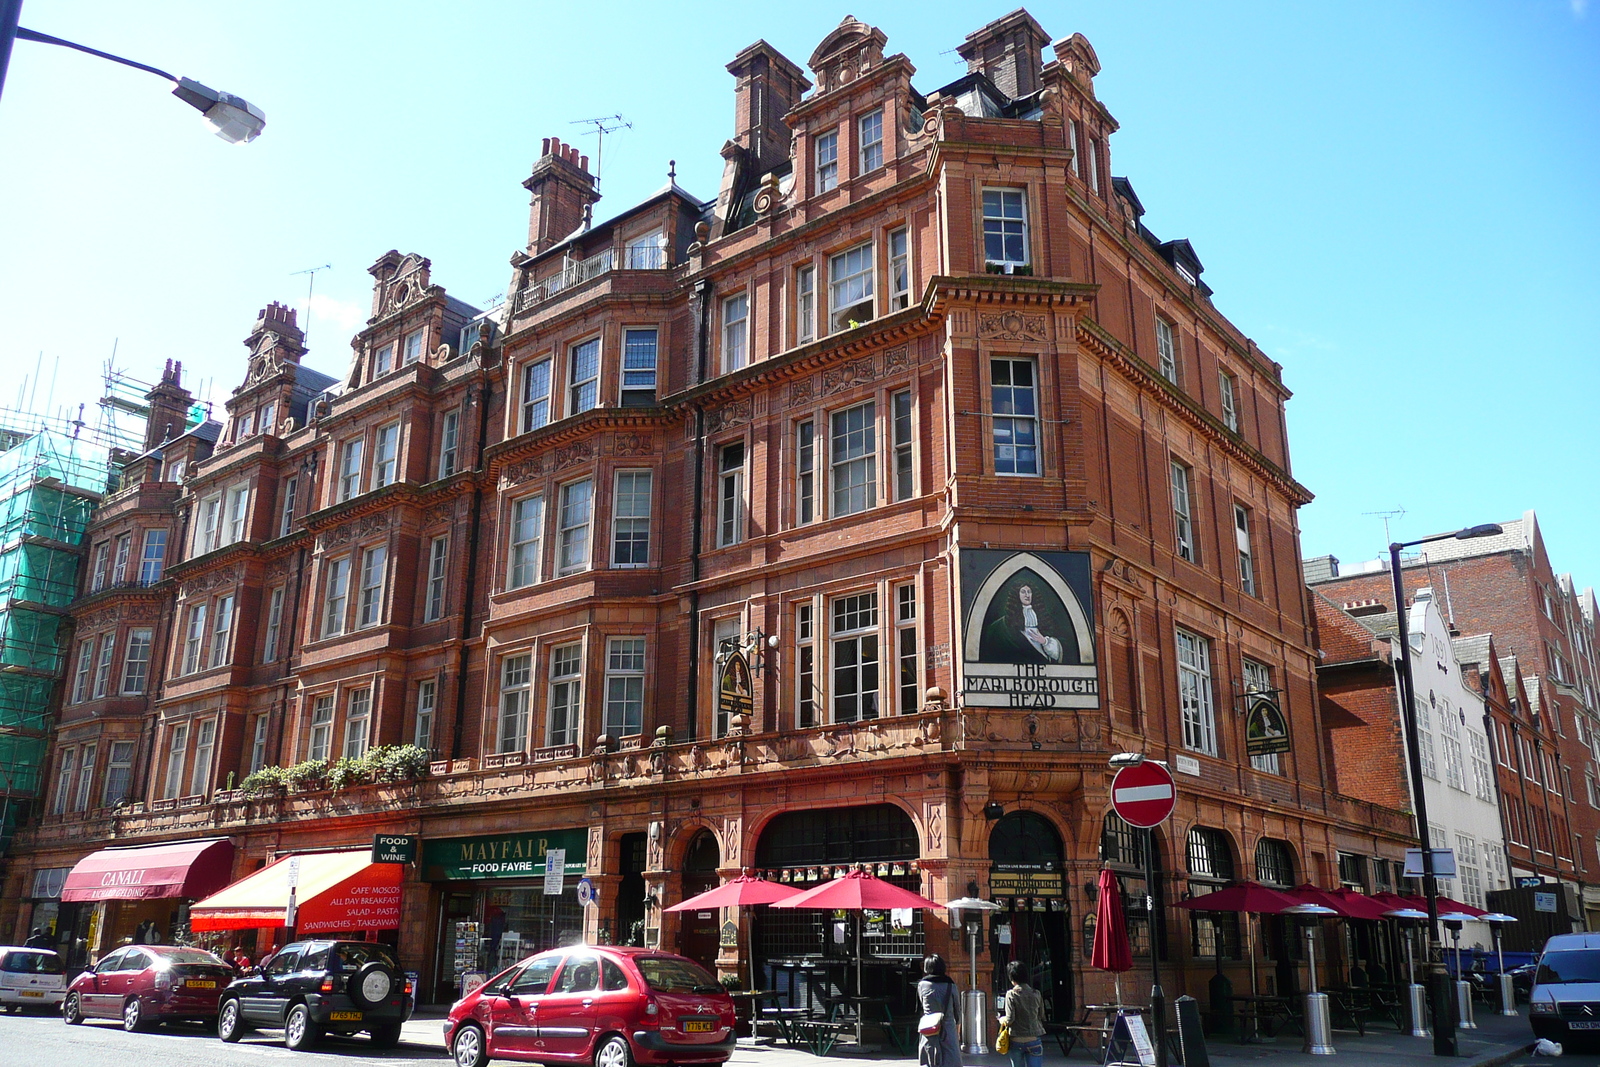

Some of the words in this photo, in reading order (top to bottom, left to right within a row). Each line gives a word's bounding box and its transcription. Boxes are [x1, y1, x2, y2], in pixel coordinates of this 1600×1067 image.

[1013, 664, 1046, 677] THE
[967, 678, 1096, 693] MARLBOROUGH
[1010, 693, 1056, 707] HEAD
[461, 839, 548, 860] MAYFAIR
[473, 863, 499, 873] FOOD
[501, 861, 532, 871] FAYRE
[101, 870, 145, 886] CANALI
[115, 888, 144, 898] GELDING
[372, 886, 400, 894] MOSCOS
[330, 898, 343, 906] ALL
[344, 897, 360, 906] DAY
[361, 896, 400, 905] BREAKFAST
[347, 908, 370, 916] SALAD
[377, 907, 399, 915] PASTA
[304, 921, 351, 930] SANDWICHES
[358, 919, 399, 928] TAKEAWAY
[686, 1023, 701, 1032] Y776
